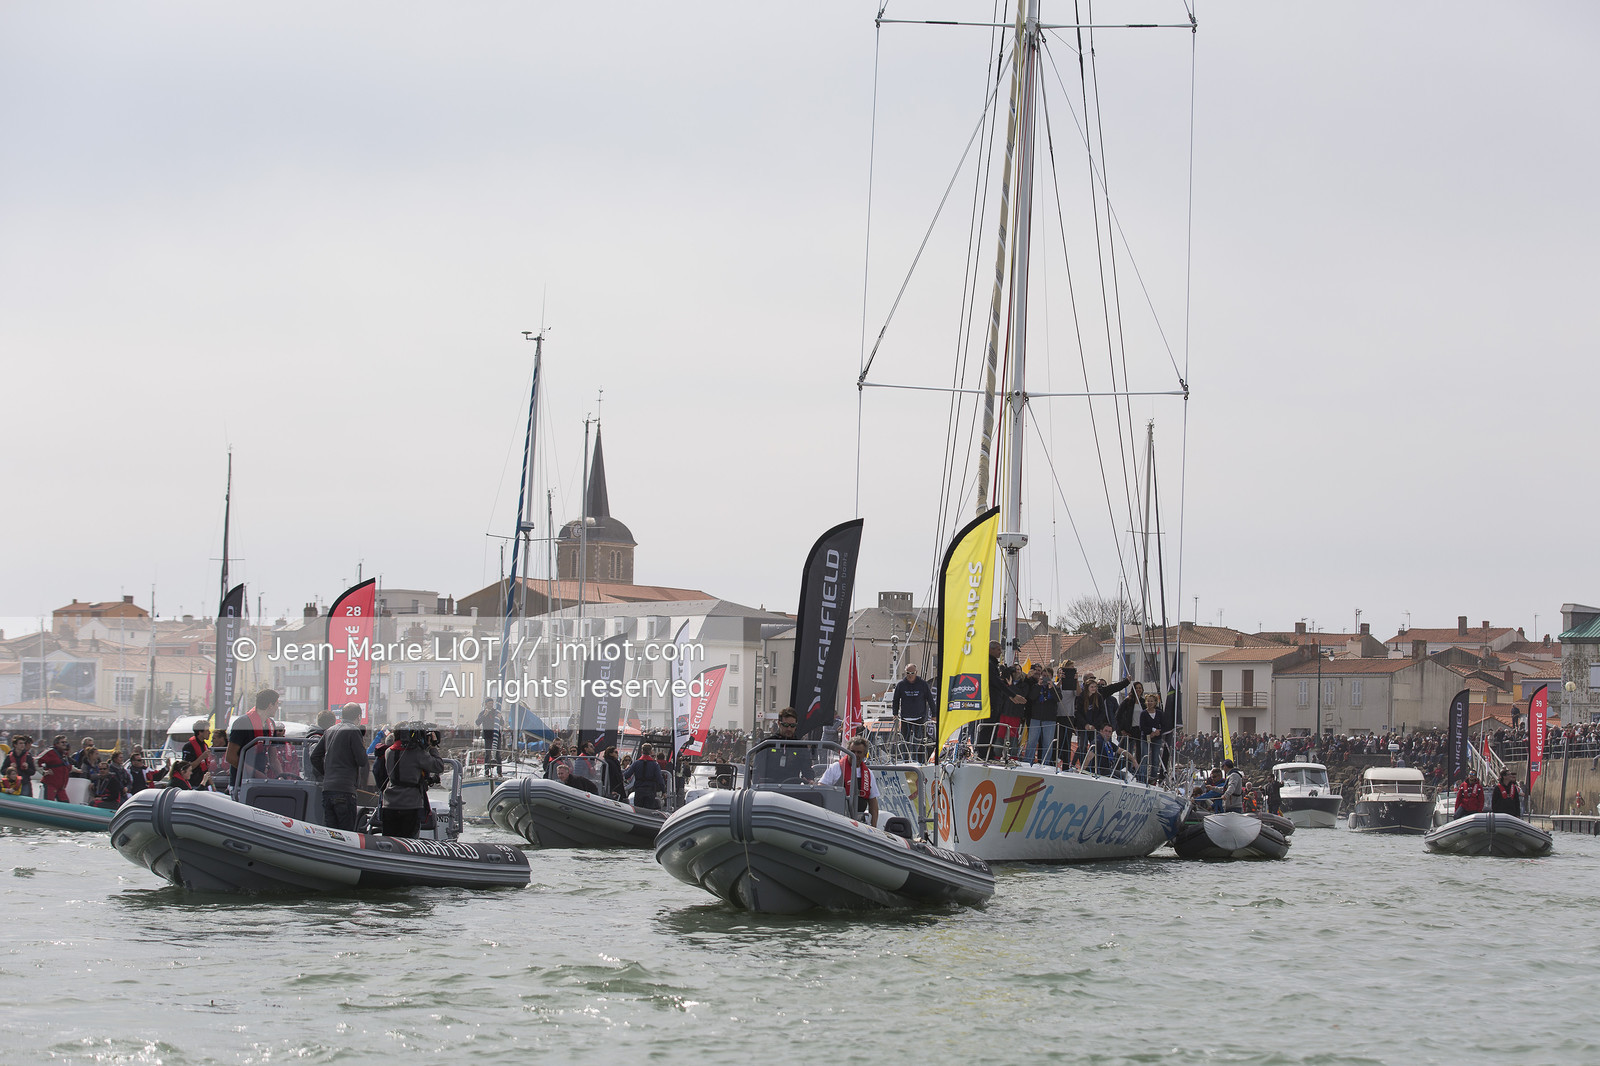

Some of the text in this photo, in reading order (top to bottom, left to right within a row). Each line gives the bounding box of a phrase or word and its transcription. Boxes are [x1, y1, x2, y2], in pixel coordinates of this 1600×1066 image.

[346, 606, 362, 617] 28
[813, 549, 841, 693] HIGHFIELD
[224, 605, 235, 705] HIGHFIELD
[704, 679, 715, 687] 42
[1454, 702, 1463, 766] HIGHFIELD
[1536, 712, 1544, 757] SÉCURITÉ
[968, 793, 993, 830] 69
